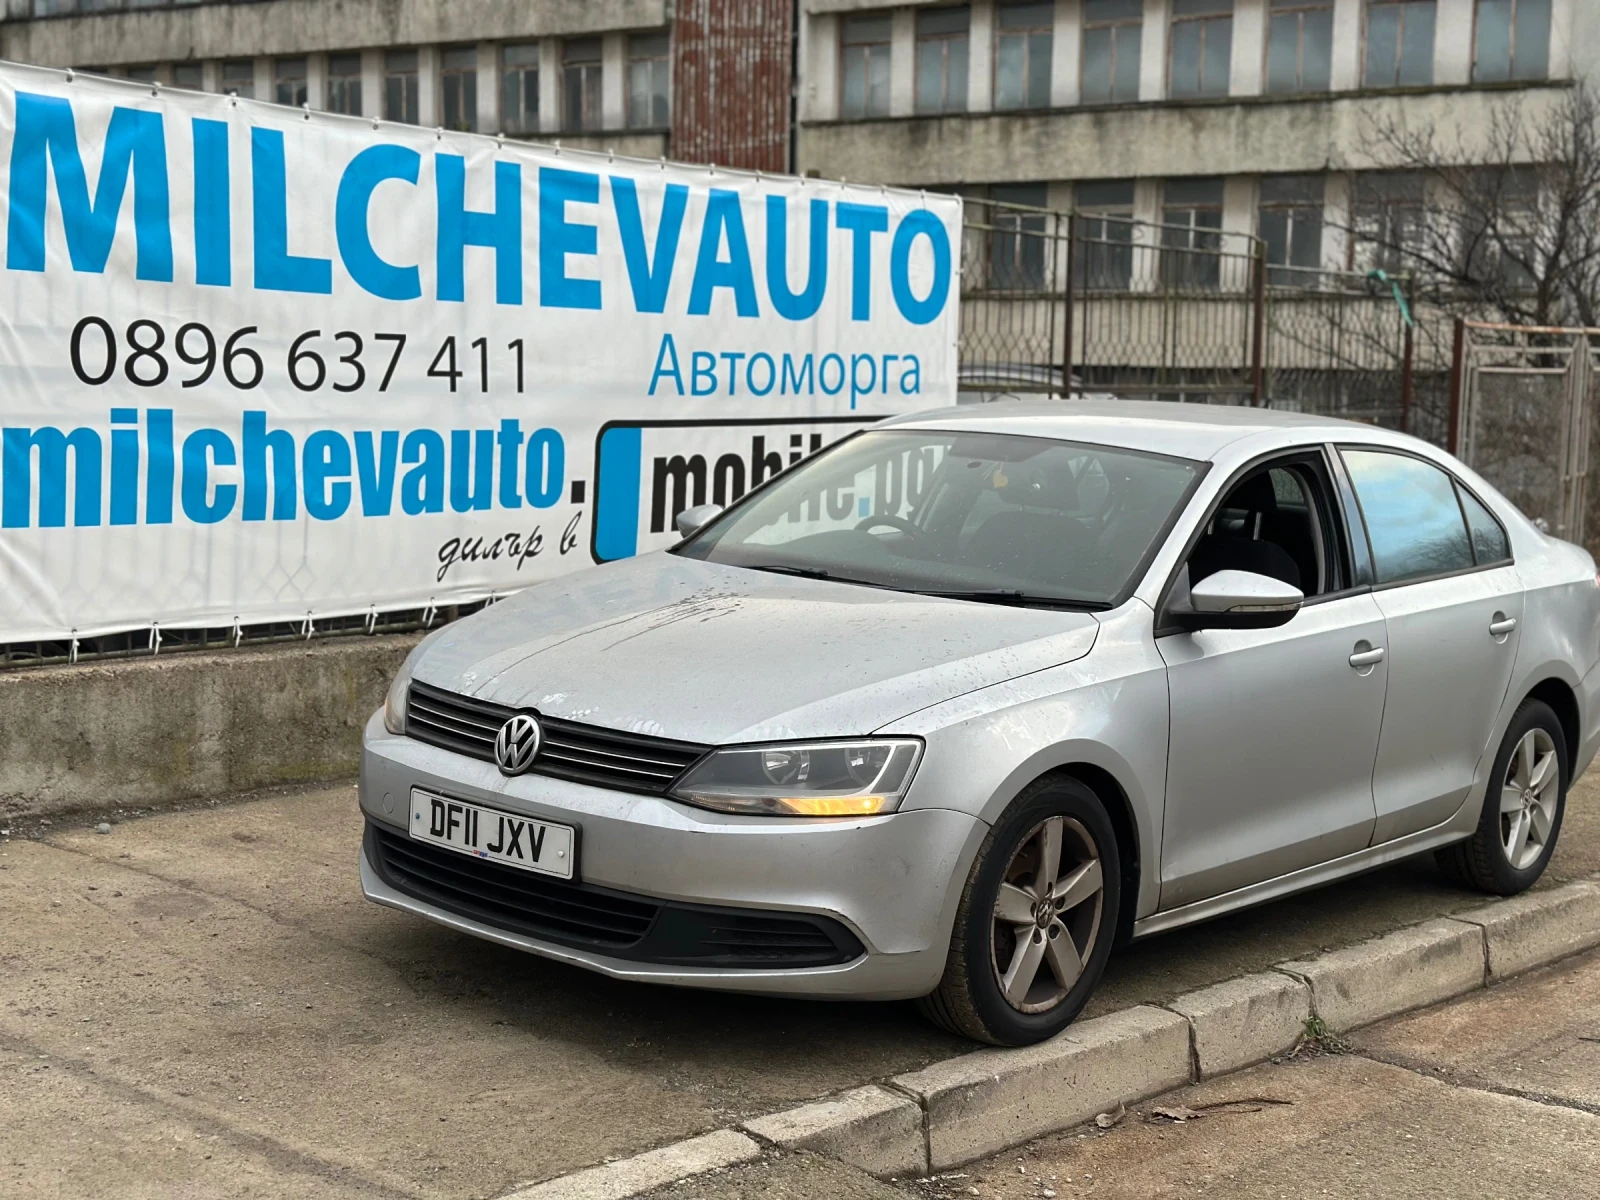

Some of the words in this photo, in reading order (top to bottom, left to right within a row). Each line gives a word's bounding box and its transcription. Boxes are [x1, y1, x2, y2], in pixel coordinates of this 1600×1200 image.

[7, 91, 952, 325] MILCHEVAUTO
[70, 316, 264, 390] 0896
[287, 330, 407, 392] 637
[427, 336, 524, 394] 411
[647, 333, 921, 410] Автоморга
[437, 525, 544, 583] дилър
[430, 799, 478, 847] DF11
[487, 816, 546, 862] JXV
